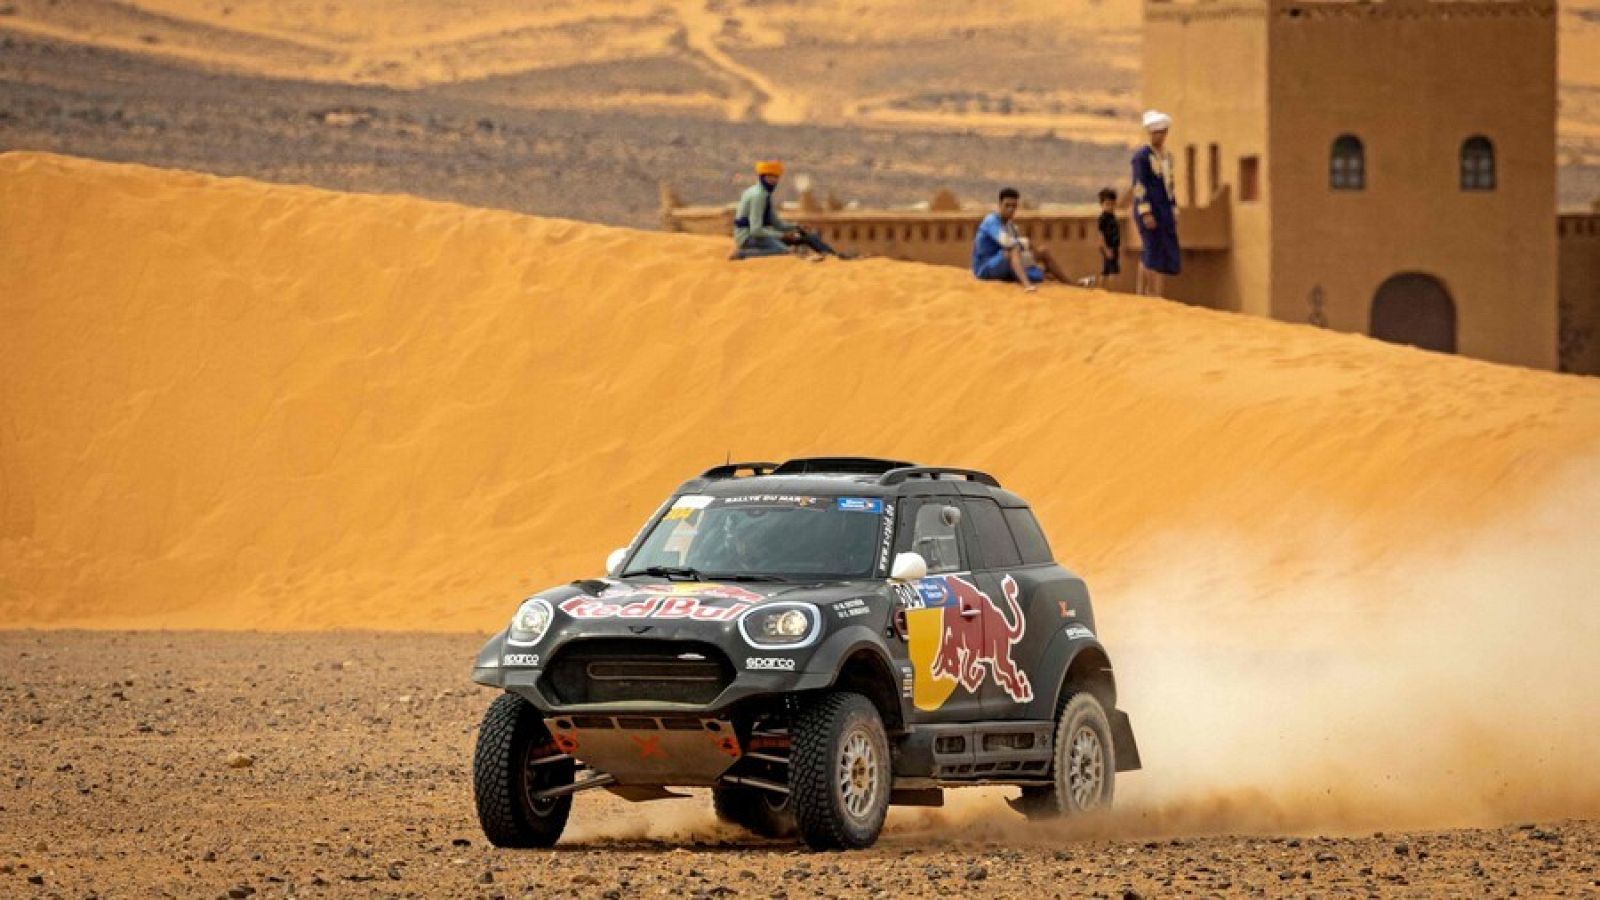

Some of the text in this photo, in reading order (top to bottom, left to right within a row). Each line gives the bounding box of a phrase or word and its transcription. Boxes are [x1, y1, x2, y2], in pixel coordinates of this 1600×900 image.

[558, 596, 660, 619] Red
[503, 654, 540, 666] sparco
[745, 657, 796, 671] sparco
